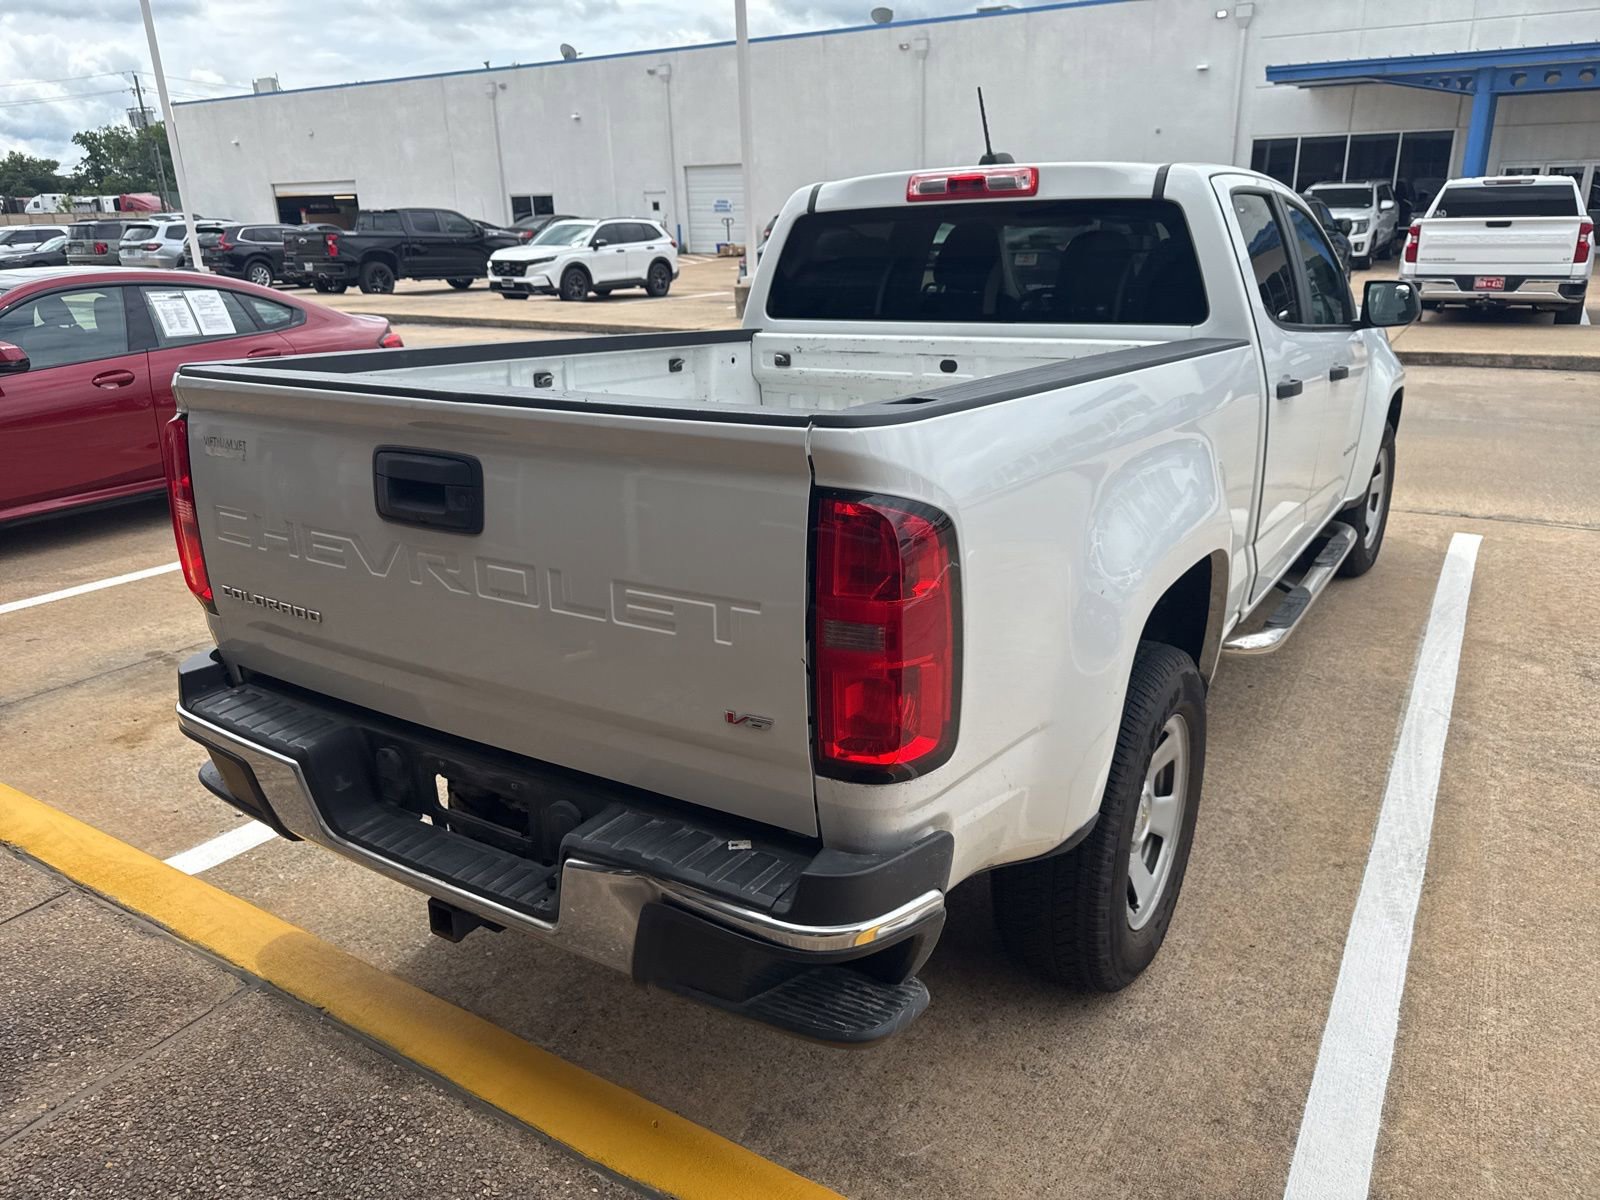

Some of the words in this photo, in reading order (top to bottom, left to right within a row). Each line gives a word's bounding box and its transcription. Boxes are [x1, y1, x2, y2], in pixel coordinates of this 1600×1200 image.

[215, 505, 762, 645] CHEVROLET
[221, 584, 323, 623] COLORADO
[724, 709, 775, 731] V6
